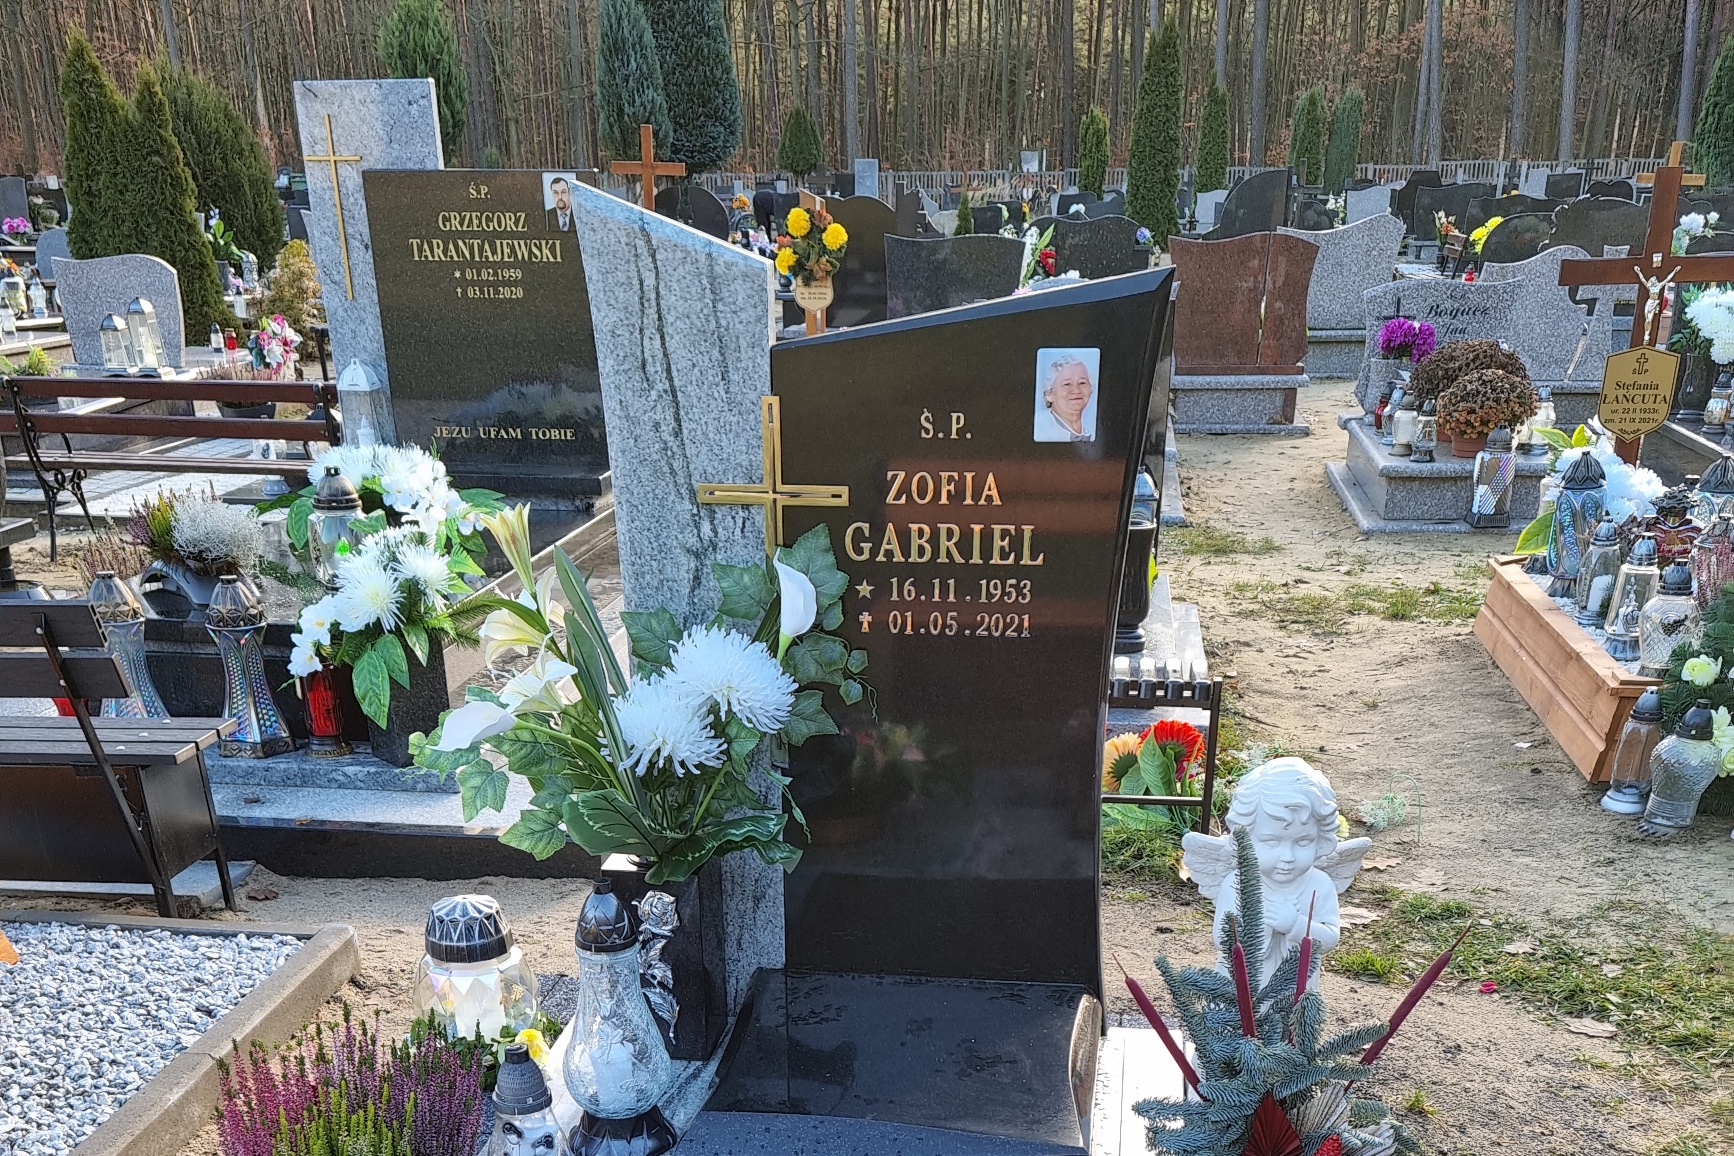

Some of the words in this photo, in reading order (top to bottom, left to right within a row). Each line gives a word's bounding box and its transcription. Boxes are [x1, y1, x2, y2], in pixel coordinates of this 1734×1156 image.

[468, 181, 491, 199] Ś.P.
[437, 211, 528, 232] GRZEGORZ
[408, 238, 563, 263] TARANTAJEWSKI
[465, 268, 523, 281] 01.02.1959
[467, 286, 524, 299] 03.11.2020
[1614, 380, 1660, 391] Stefania
[1602, 391, 1668, 405] ŁAŃCUTA
[434, 425, 471, 438] JEZU
[478, 426, 522, 440] UFAM
[528, 427, 576, 441] TOBIE
[885, 470, 1003, 506] ZOFIA
[844, 521, 1045, 567] GABRIEL
[889, 577, 1033, 604] 16.11.1953
[888, 610, 1033, 639] 01.05.2021
